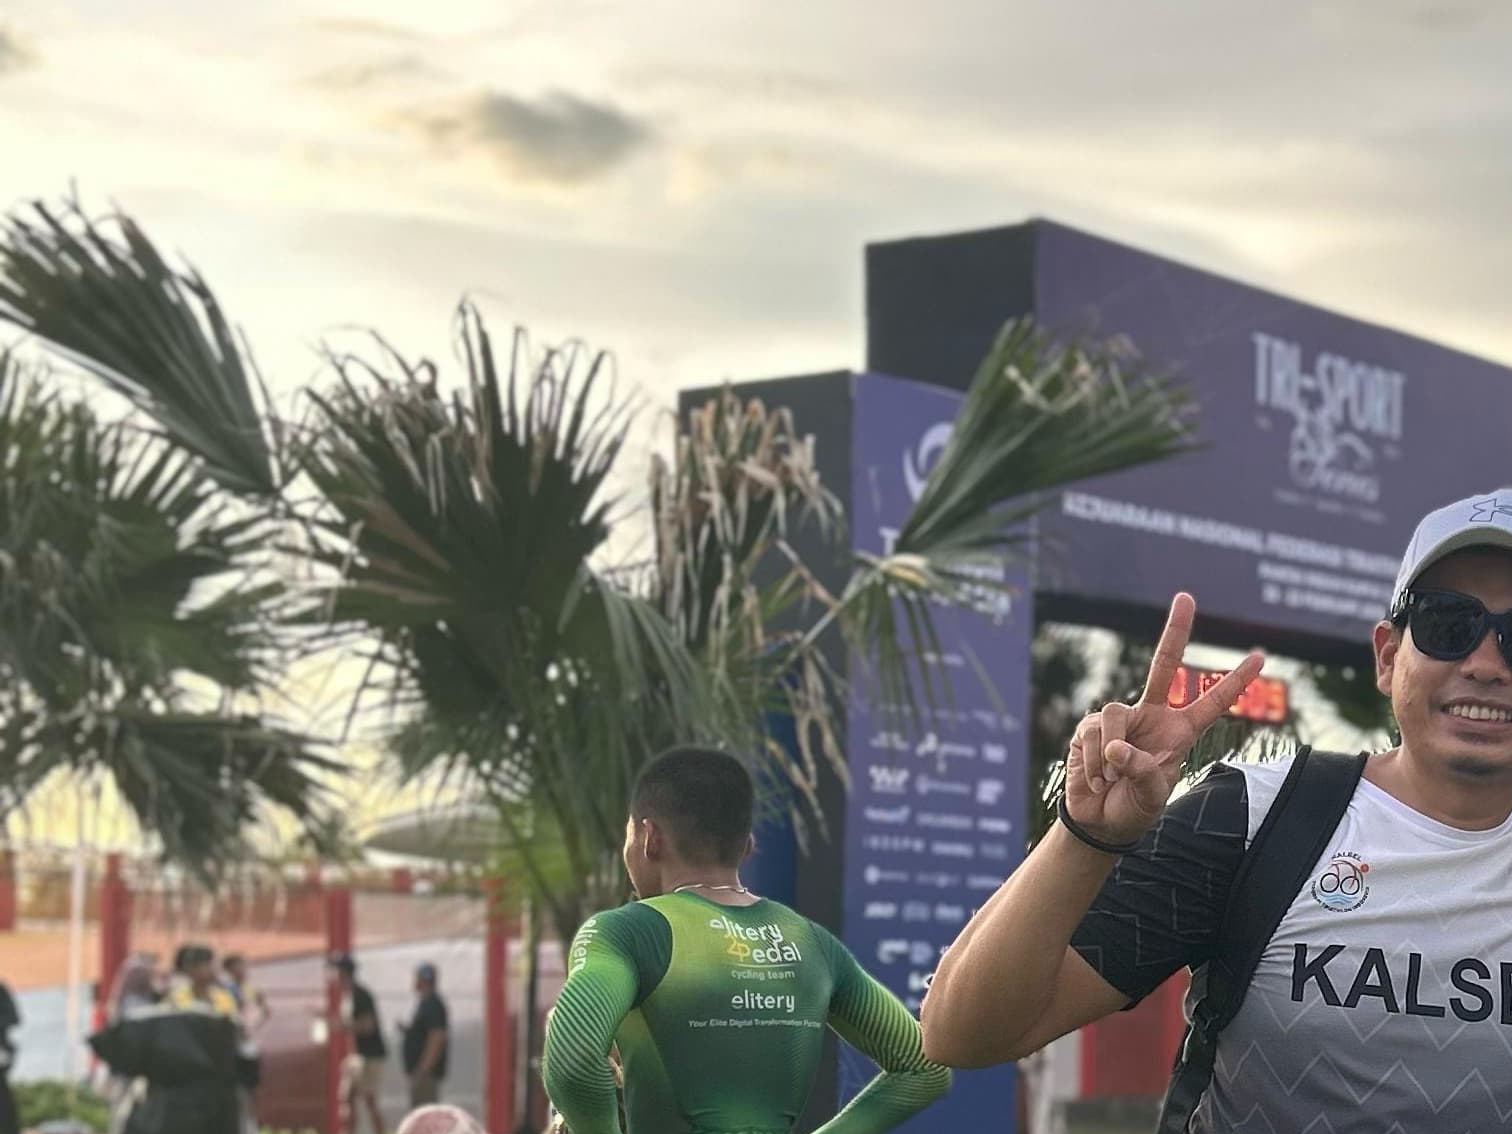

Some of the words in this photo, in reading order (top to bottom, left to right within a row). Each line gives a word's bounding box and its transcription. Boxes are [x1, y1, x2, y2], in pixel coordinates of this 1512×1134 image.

[1250, 331, 1405, 440] TRI-SPORT
[709, 915, 784, 942] elitery
[767, 970, 796, 980] team
[731, 989, 796, 1013] elitery
